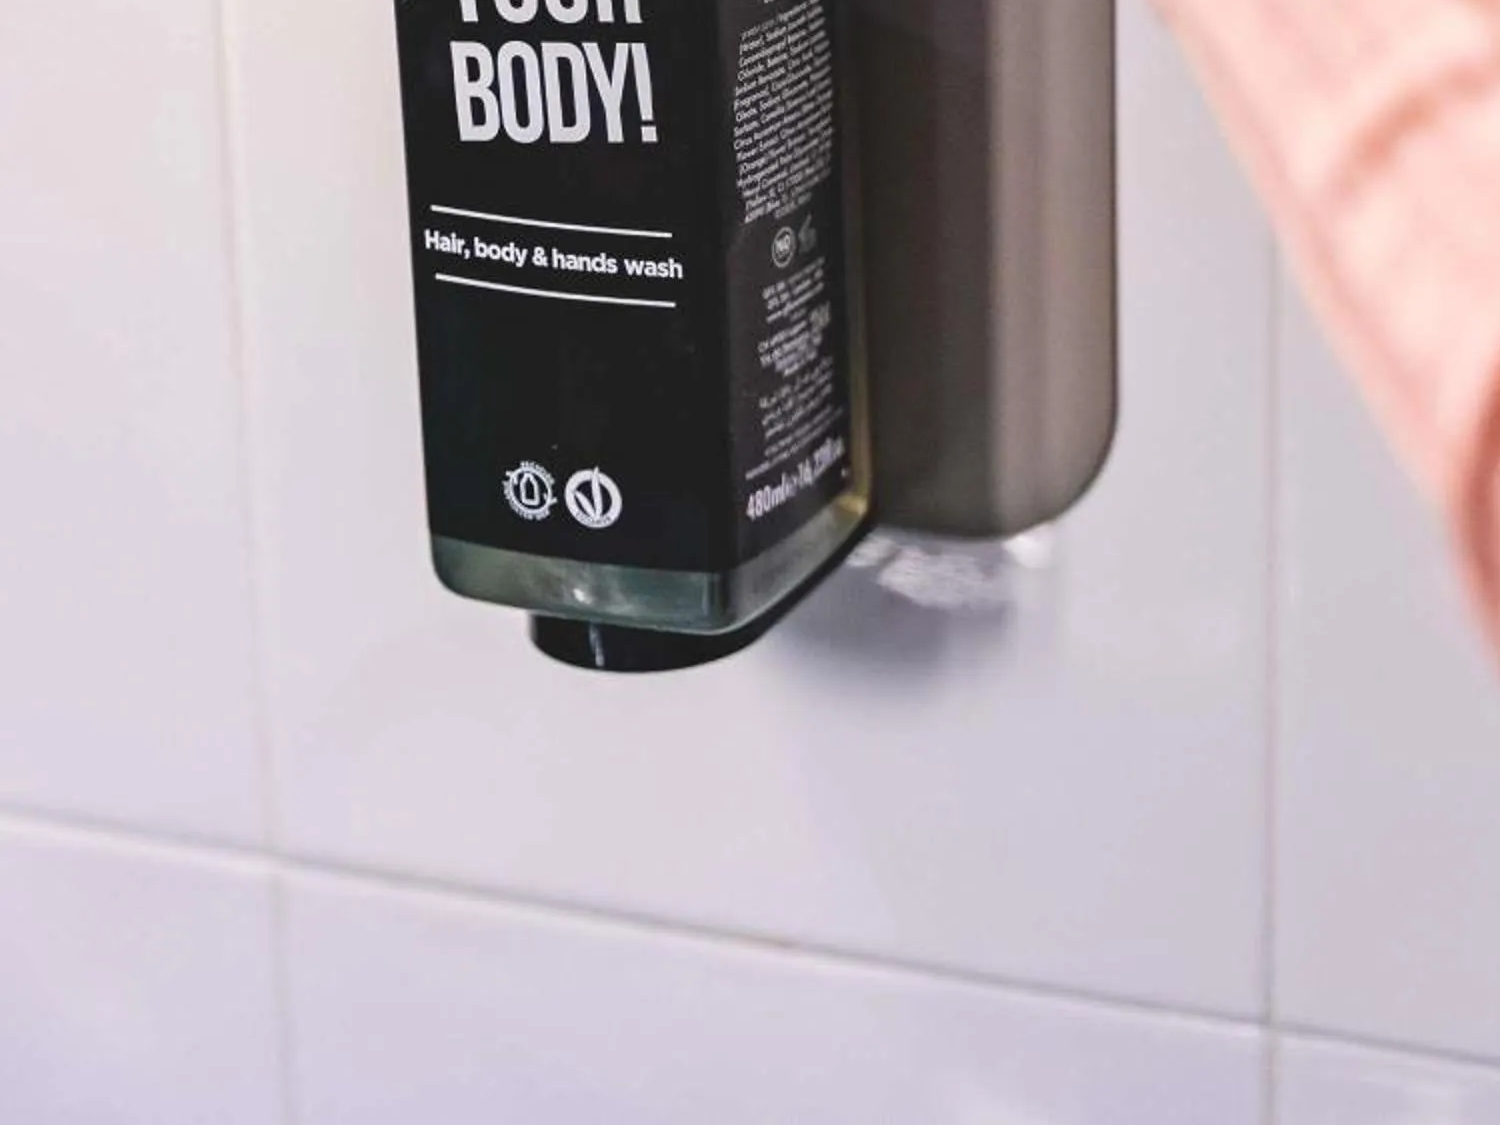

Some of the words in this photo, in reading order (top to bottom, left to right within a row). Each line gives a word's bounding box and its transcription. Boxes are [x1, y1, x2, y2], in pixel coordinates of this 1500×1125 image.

[450, 40, 658, 144] BODY!
[424, 228, 471, 259] Hair,
[474, 236, 528, 268] body
[531, 246, 549, 268] &
[552, 248, 618, 274] hands
[624, 257, 683, 279] wash
